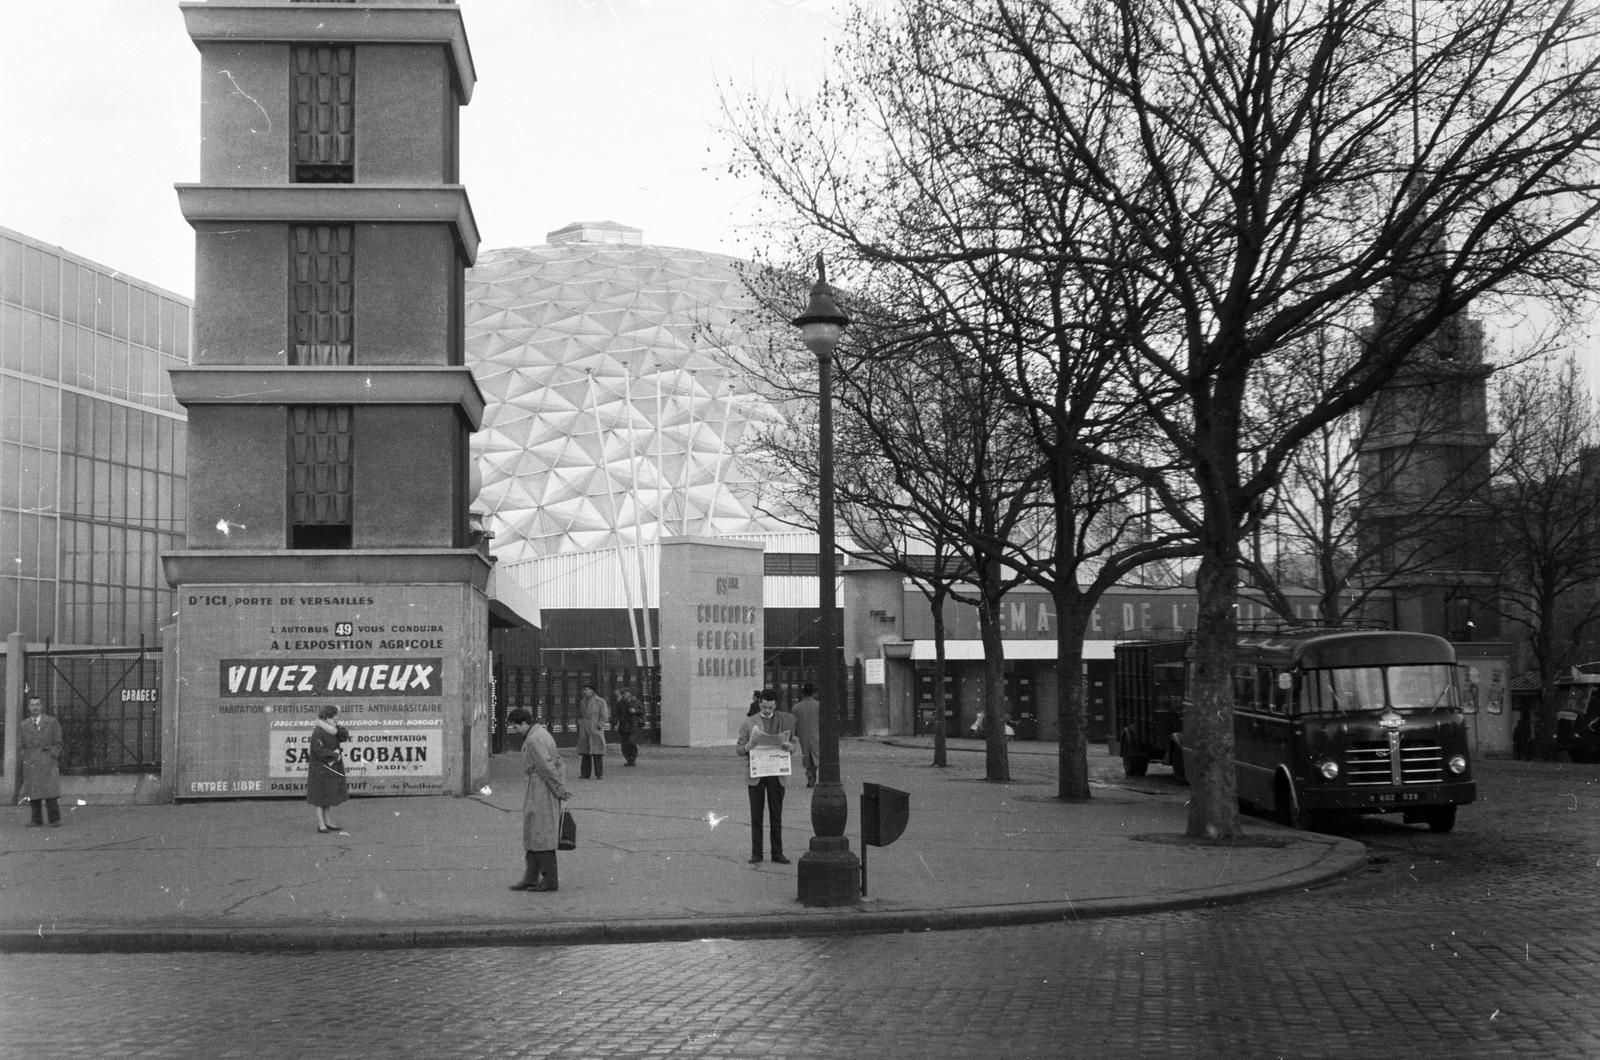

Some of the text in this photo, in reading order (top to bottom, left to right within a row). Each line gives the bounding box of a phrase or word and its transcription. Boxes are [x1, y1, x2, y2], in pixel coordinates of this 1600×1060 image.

[235, 597, 273, 606] PORTE
[280, 597, 295, 606] DE
[300, 597, 374, 605] VERSAILLES
[697, 603, 756, 624] CONCOURS
[1123, 603, 1151, 631] DE
[335, 623, 352, 635] 49
[358, 625, 385, 633] VOUS
[270, 640, 443, 650] A L'EXPOSITION AGRICOLE
[697, 630, 756, 650] GENERAL
[697, 657, 757, 677] AGRICOLE
[228, 664, 434, 693] VIVEZ MIEUX
[121, 689, 156, 702] GARAGE C
[219, 704, 264, 714] HABITATION
[341, 704, 364, 713] LUTTE
[367, 703, 443, 713] ANTIPARASITAIRE
[285, 736, 297, 744] AU
[357, 735, 427, 743] DOCUMENTATION
[191, 781, 261, 792] ENTRÉE LIBRE
